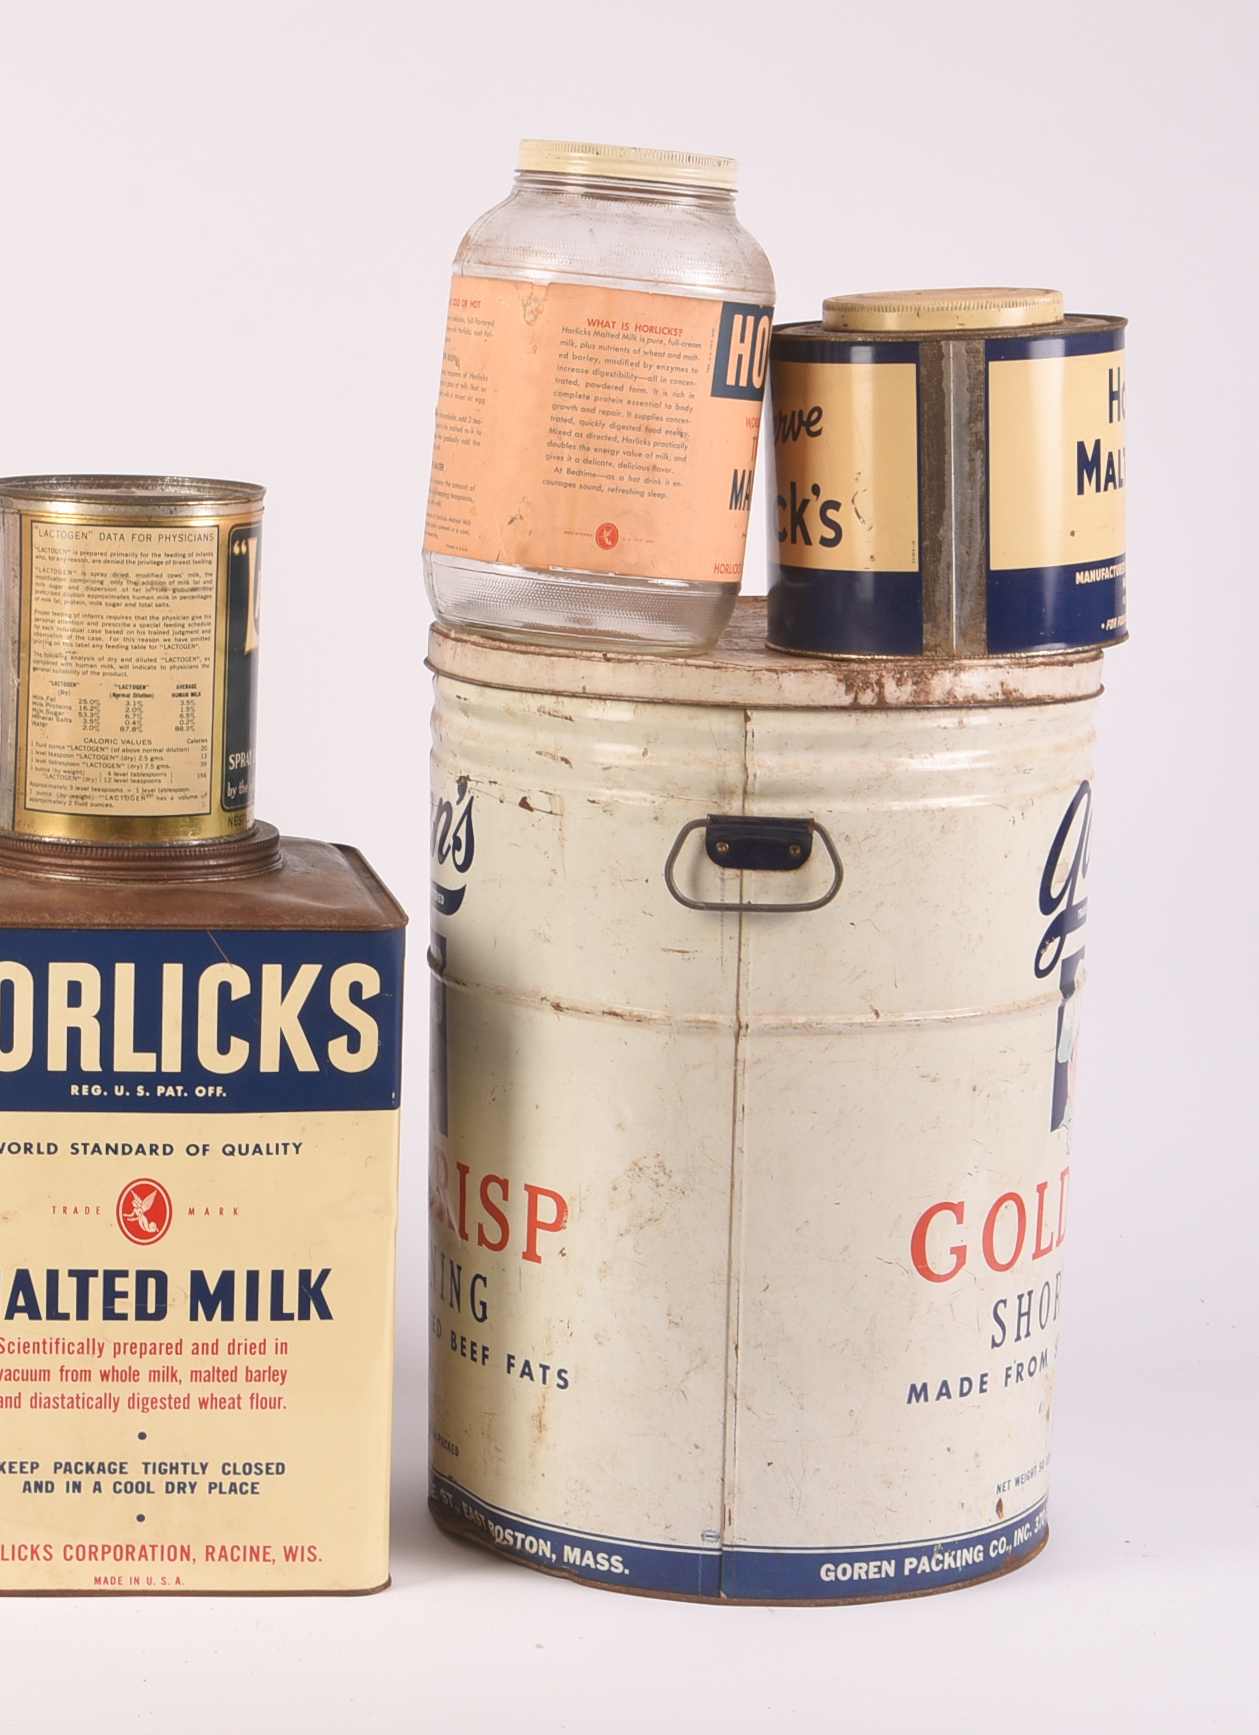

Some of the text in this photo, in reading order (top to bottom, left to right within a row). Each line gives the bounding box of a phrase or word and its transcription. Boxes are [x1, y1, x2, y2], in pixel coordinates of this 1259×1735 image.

[562, 326, 591, 336] Horlicks
[593, 330, 620, 340] Malted
[622, 333, 637, 341] Milk
[647, 336, 666, 345] pure,
[668, 338, 701, 349] full-cream
[587, 318, 683, 337] WHAT IS HORLICKS?
[34, 526, 214, 542] "LACTOGEN" DATA FOR PHYSICIANS
[71, 1085, 226, 1097] REG. U. S. PAT. OFF.
[71, 1143, 174, 1155] STANDARD
[186, 1144, 209, 1156] OF
[222, 1143, 302, 1156] QUALITY
[52, 1206, 238, 1215] TRADE MARK
[190, 1269, 333, 1321] MILK
[114, 1338, 182, 1358] prepared
[192, 1339, 218, 1355] and
[228, 1338, 266, 1355] dried
[275, 1338, 287, 1355] in
[451, 1330, 570, 1390] BEEF FATS
[59, 1365, 91, 1382] from
[100, 1366, 140, 1382] whole
[149, 1366, 181, 1384] milk,
[190, 1366, 237, 1382] malted
[246, 1366, 287, 1385] barley
[907, 1348, 1048, 1404] MADE FROM
[30, 1392, 120, 1413] diastatically
[128, 1393, 190, 1413] digested
[198, 1393, 241, 1410] wheat
[249, 1393, 286, 1409] flour.
[54, 1462, 128, 1474] PACKAGE
[142, 1462, 208, 1475] TIGHTLY
[222, 1463, 285, 1475] CLOSED
[23, 1481, 259, 1495] AND IN A COOL DRY PLACE
[996, 1481, 1011, 1494] NET
[1015, 1466, 1037, 1487] WEIGHT
[462, 1501, 486, 1527] EAST
[488, 1520, 557, 1562] BOSTON,
[563, 1545, 629, 1574] MASS.
[63, 1544, 196, 1564] CORPORATION,
[206, 1545, 275, 1564] RACINE,
[283, 1545, 322, 1562] WIS.
[820, 1560, 895, 1582] GOREN
[904, 1545, 983, 1576] PACKING
[1014, 1526, 1032, 1546] INC.
[94, 1576, 183, 1585] MADE IN U. S. A.
